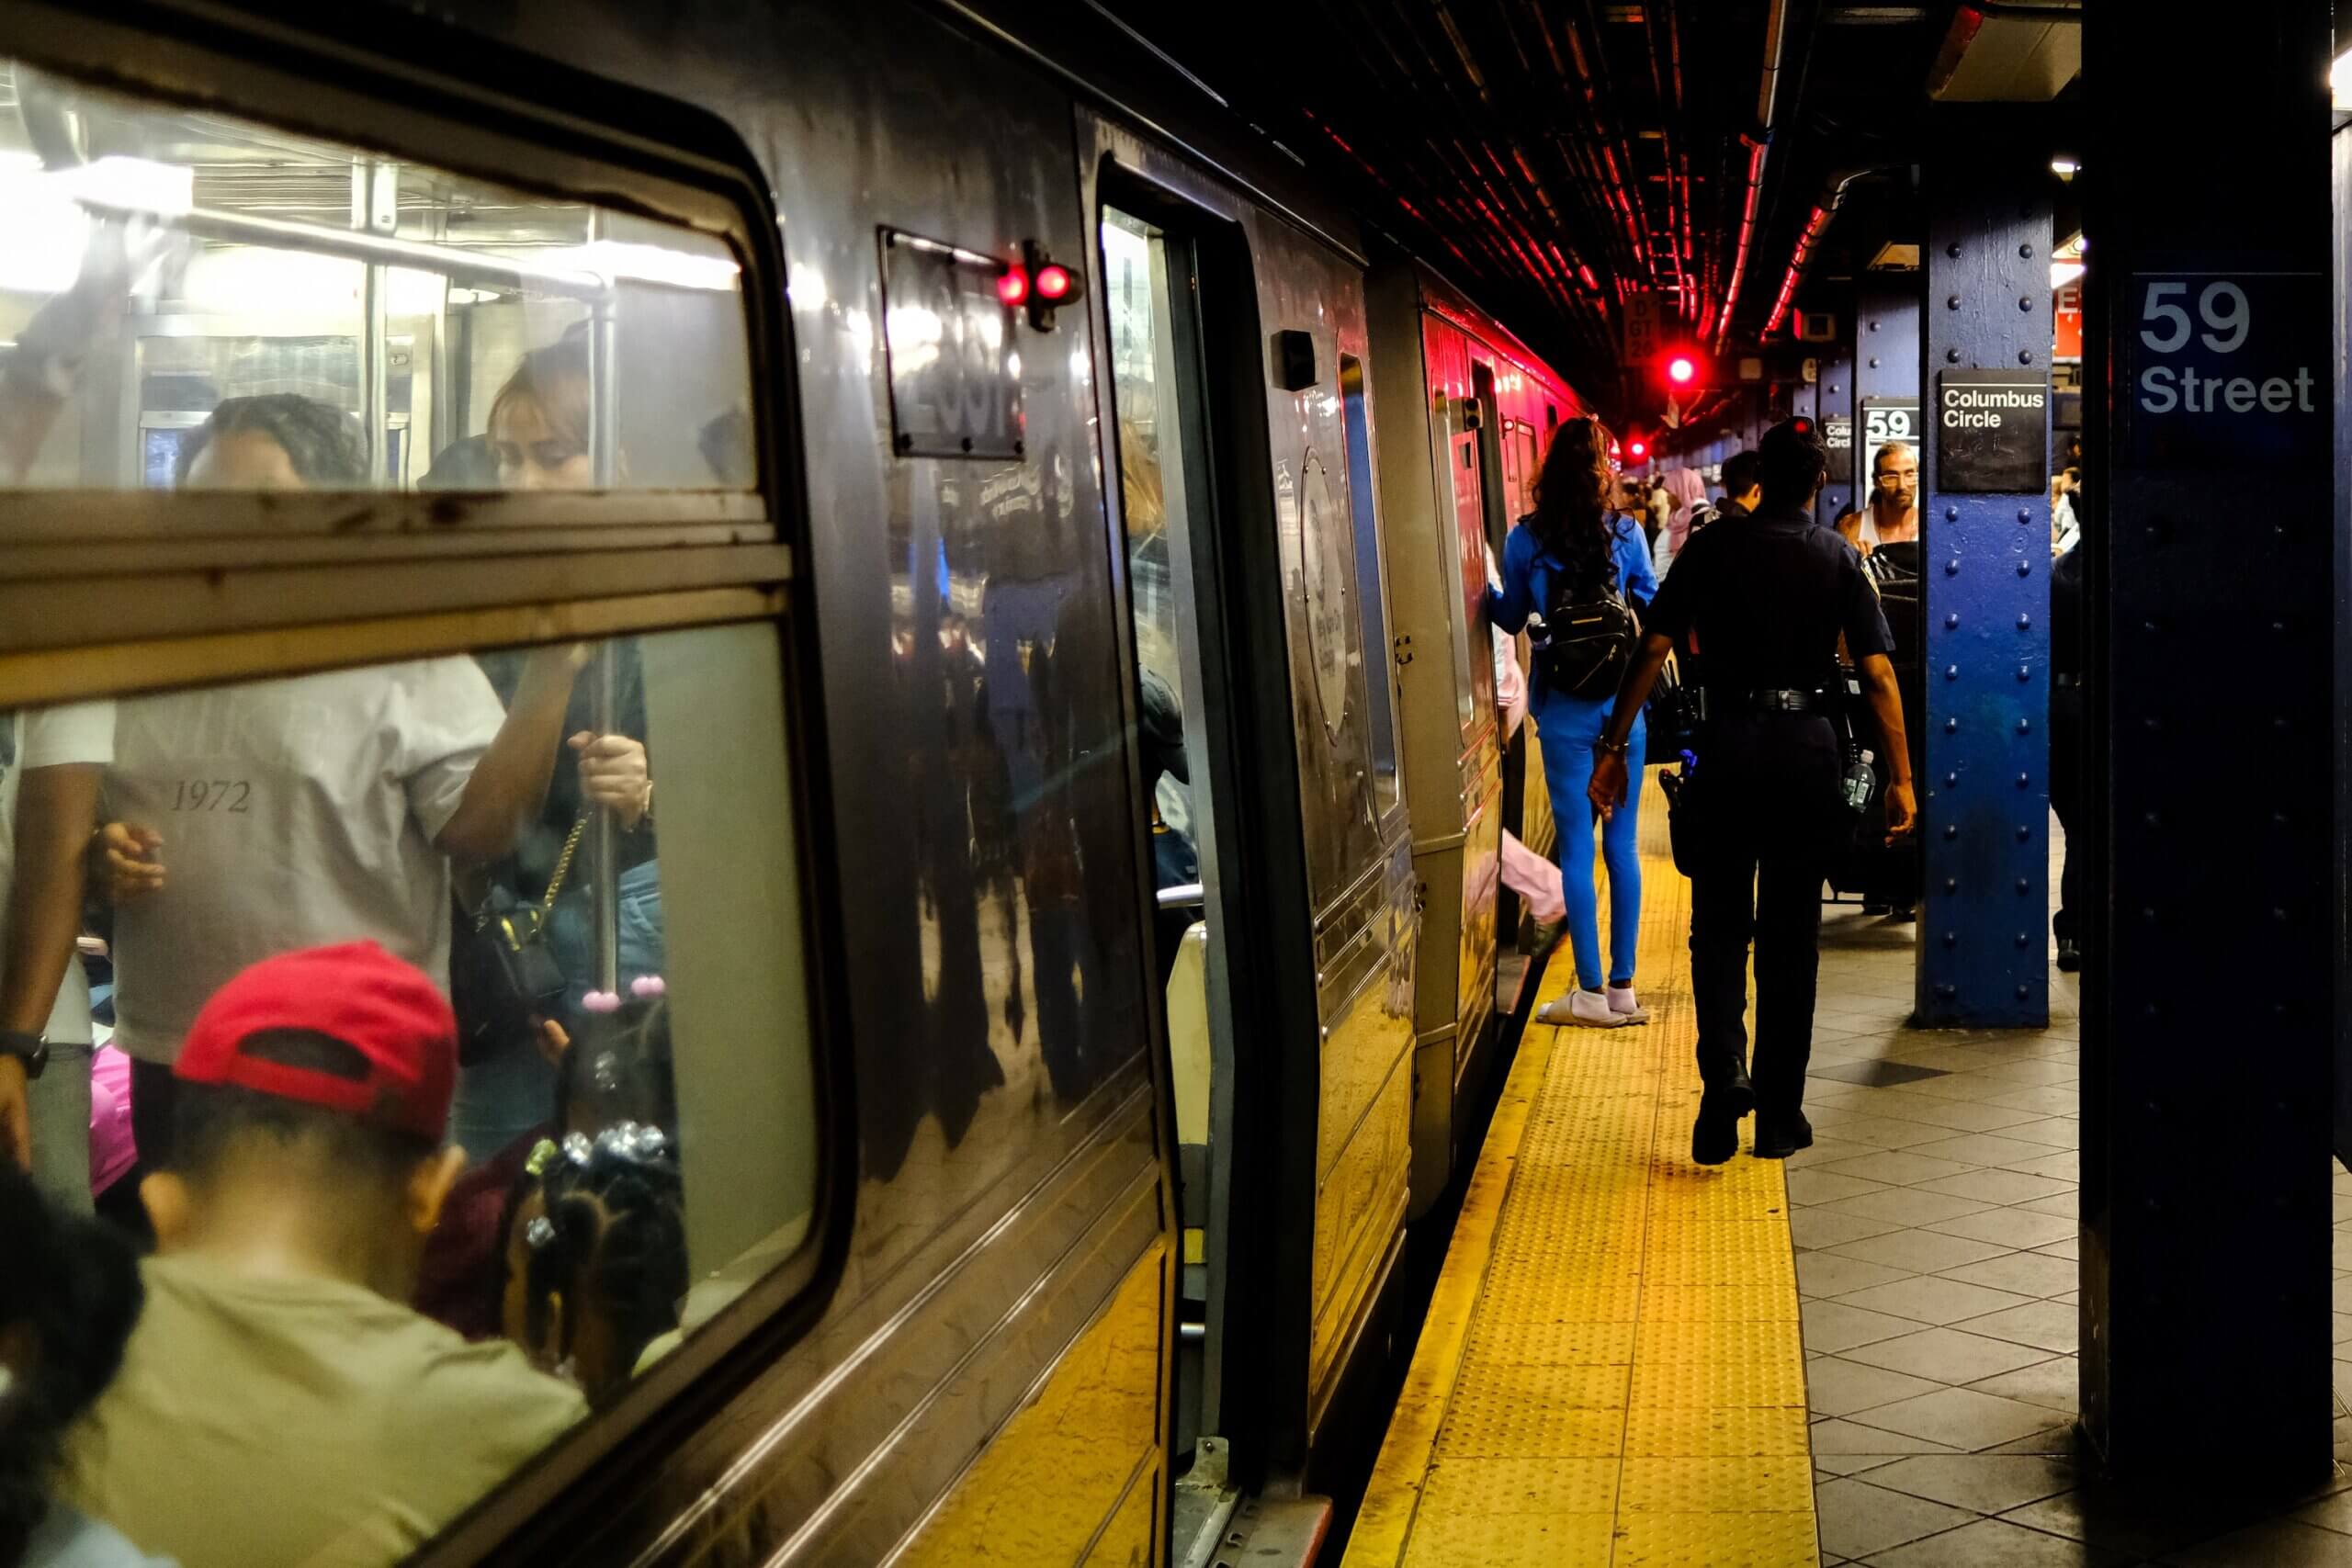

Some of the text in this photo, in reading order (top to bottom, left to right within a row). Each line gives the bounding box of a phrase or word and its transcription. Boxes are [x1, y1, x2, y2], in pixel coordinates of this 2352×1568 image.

[2140, 280, 2250, 354] 59
[1944, 389, 2044, 408] Columbus
[2140, 366, 2314, 413] Street
[1865, 410, 1911, 437] 59
[1943, 409, 2002, 428] Circle
[1826, 425, 1851, 436] Colu
[1826, 437, 1851, 448] Circl
[169, 779, 251, 814] 1972
